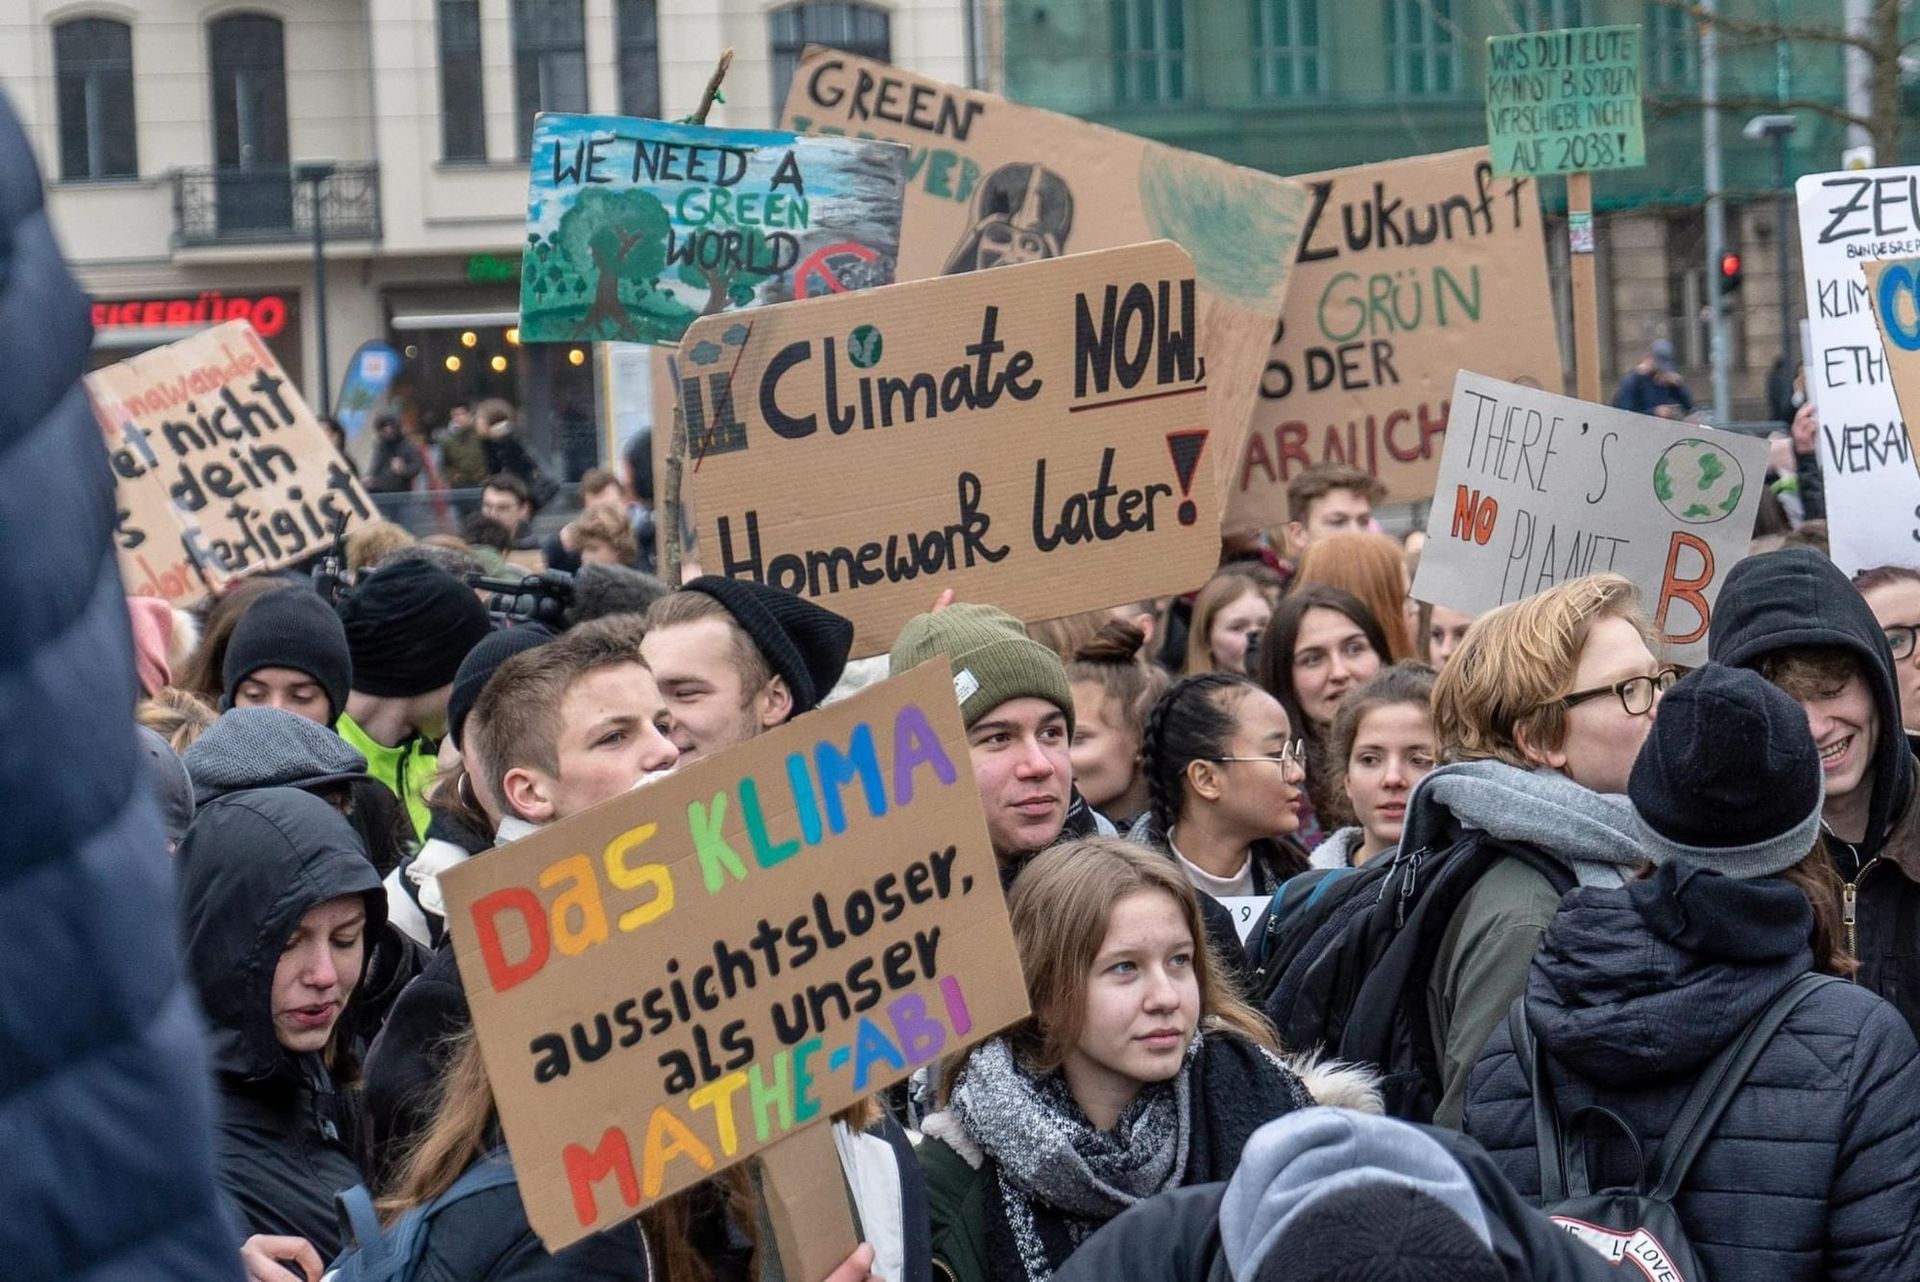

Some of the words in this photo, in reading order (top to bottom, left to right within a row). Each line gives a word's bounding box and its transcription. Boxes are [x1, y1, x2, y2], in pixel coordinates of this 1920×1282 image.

[1490, 37, 1529, 70] WAS
[1562, 65, 1639, 98] BSORGEN
[807, 60, 984, 141] GREEN
[553, 137, 614, 185] WE
[632, 140, 747, 187] NEED
[769, 150, 804, 196] A
[1510, 138, 1548, 172] AUF
[676, 187, 809, 229] GREEN
[1296, 161, 1530, 264] Zukunft
[666, 229, 799, 275] WORLD
[90, 289, 287, 337] EISEBÜRO
[1317, 265, 1482, 342] GRÜN
[758, 305, 1042, 439] Climate
[1074, 278, 1207, 398] NOW,
[1258, 339, 1400, 399] ODER
[1824, 346, 1884, 388] ETH
[161, 368, 295, 456] nicht
[170, 444, 297, 512] dein
[717, 471, 1011, 598] Homework
[1451, 484, 1498, 546] NO
[1654, 531, 1715, 645] B
[686, 703, 958, 896] KLIMA
[529, 844, 974, 1085] aussichtsloser,
[657, 1018, 755, 1096] als
[771, 925, 942, 1046] unser
[561, 975, 973, 1228] MATHE-ABI
[1634, 1240, 1676, 1282] LOVE
